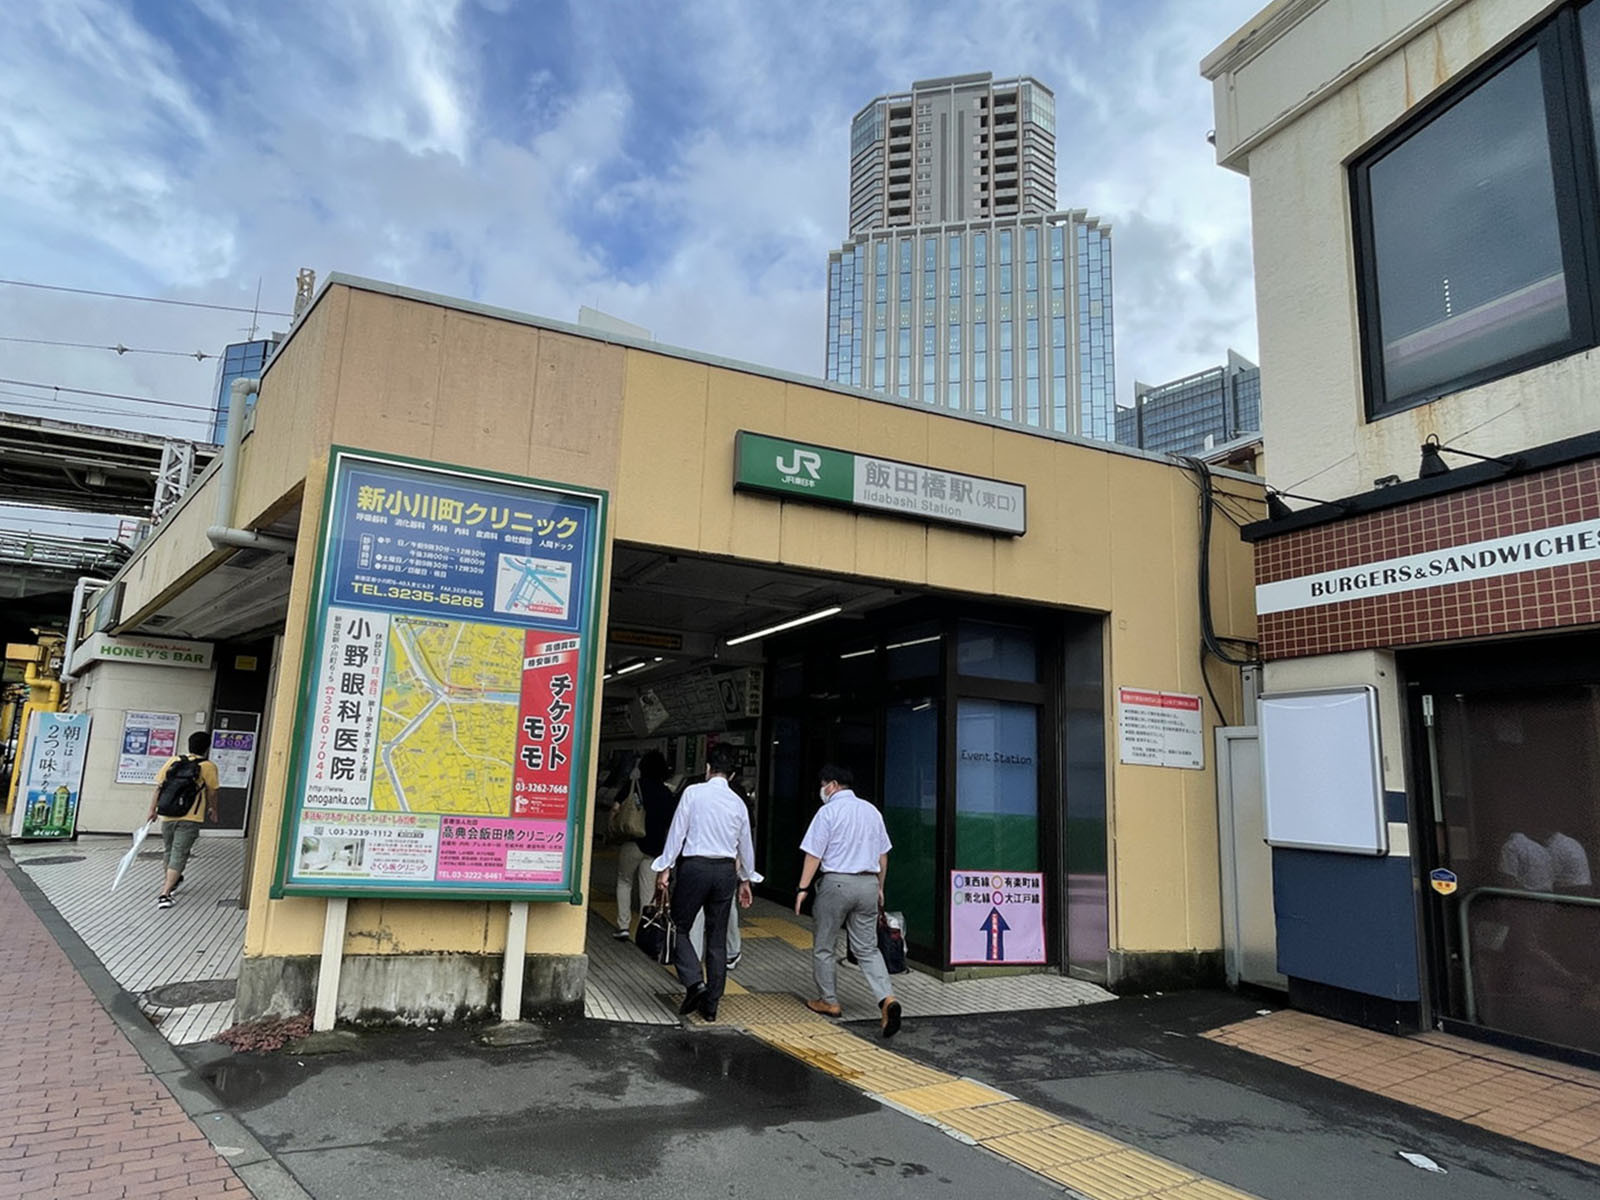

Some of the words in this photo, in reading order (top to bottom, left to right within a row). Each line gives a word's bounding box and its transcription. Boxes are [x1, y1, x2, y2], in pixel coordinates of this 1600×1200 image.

[776, 449, 821, 479] JR
[865, 461, 973, 504] 飯田橋駅
[976, 489, 1016, 513] (東口)
[357, 485, 578, 538] 新小川町クリニック
[863, 489, 917, 509] Iidabashi
[921, 499, 962, 516] Station
[1311, 530, 1600, 598] BURGERS&SANDWICHE
[351, 581, 485, 609] TEL.3235-5265
[100, 645, 168, 661] HONEY'S
[173, 651, 205, 664] BAR
[329, 616, 372, 782] 小野眼科医院
[548, 675, 572, 770] チケット
[522, 717, 545, 769] モモ
[306, 793, 368, 807] onoganka.com
